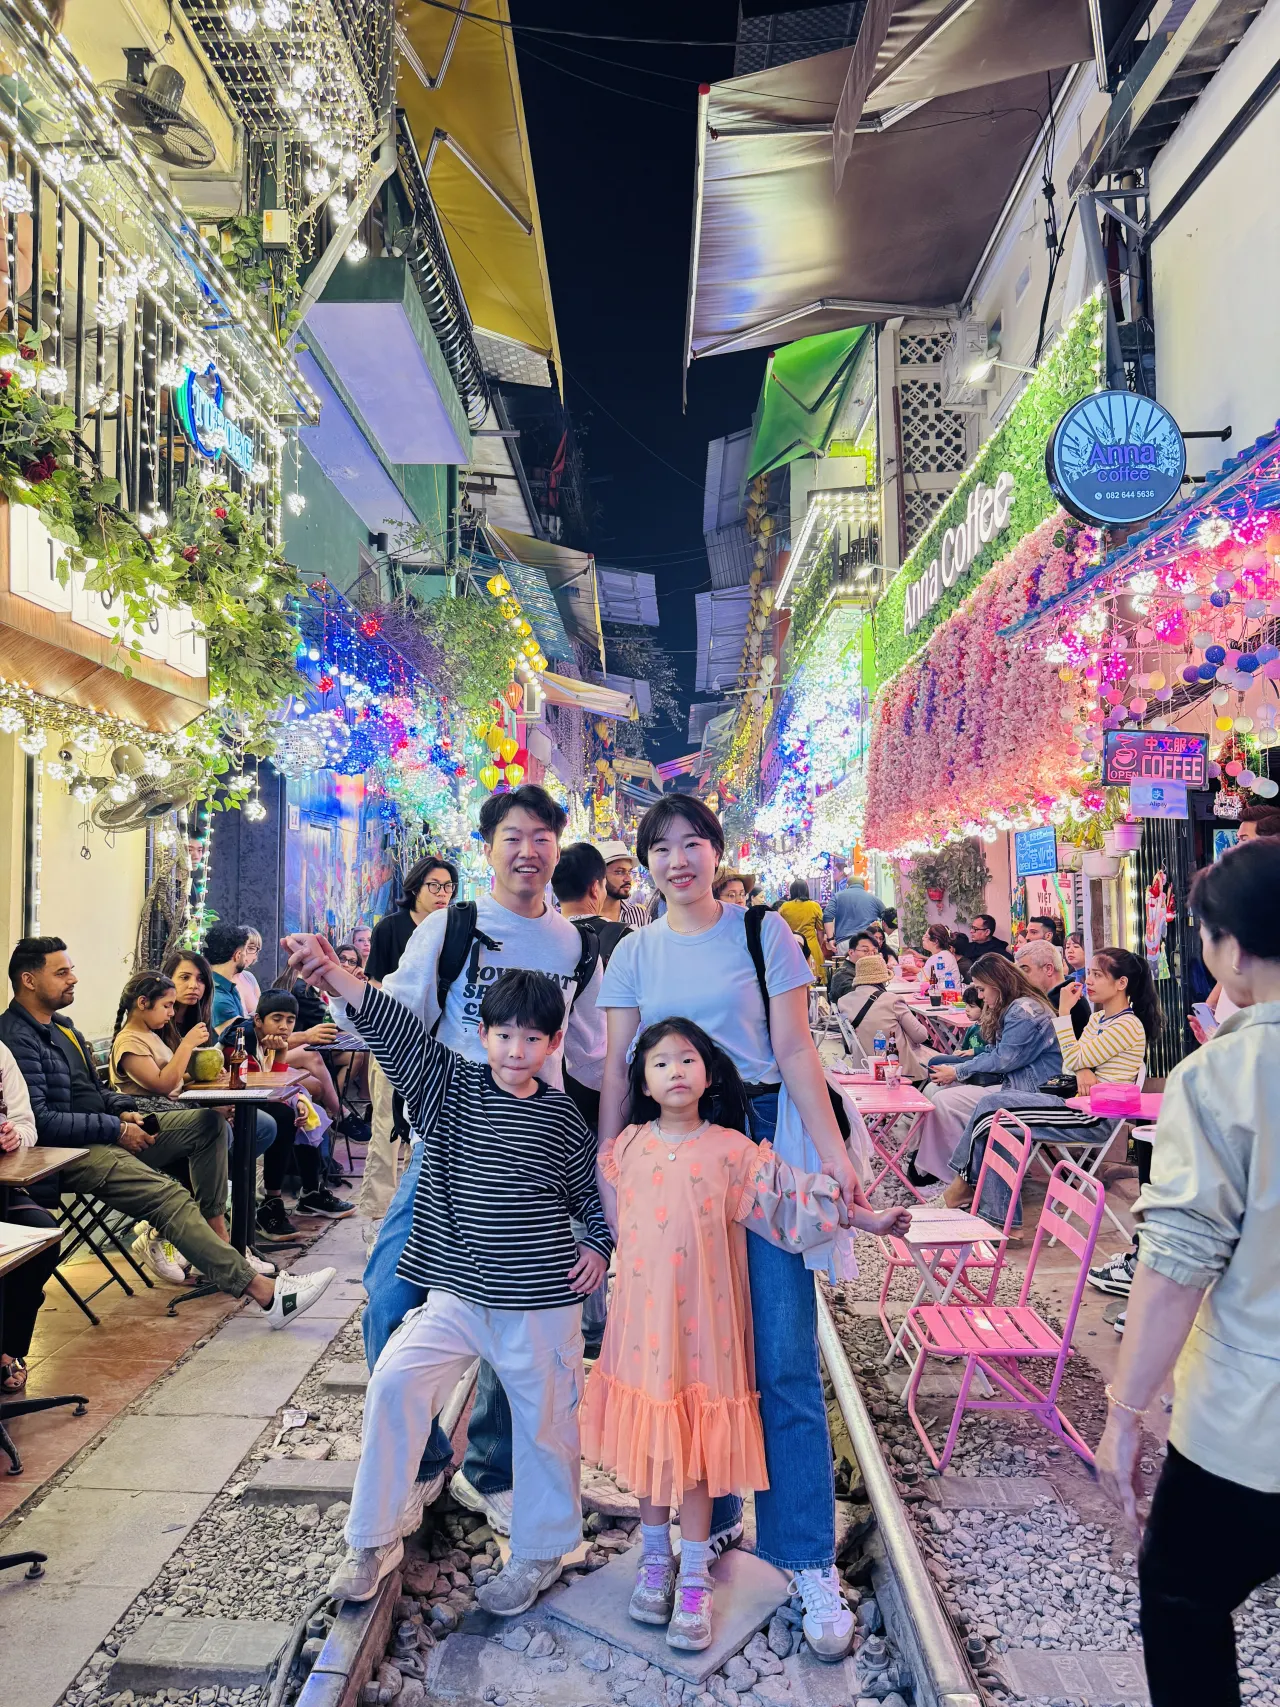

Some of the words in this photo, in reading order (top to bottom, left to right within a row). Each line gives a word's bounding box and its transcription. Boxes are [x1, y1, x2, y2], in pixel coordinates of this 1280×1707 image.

[1089, 442, 1156, 465] Anna
[1097, 466, 1150, 482] coffee
[1105, 491, 1120, 500] 082
[1121, 491, 1135, 499] 644
[1136, 490, 1155, 498] 5636
[904, 558, 945, 637] Anna
[941, 471, 1016, 589] Coffee
[1144, 736, 1203, 754] 中文服务
[1110, 770, 1139, 779] OPEN
[1141, 755, 1202, 780] COFFEE
[1028, 845, 1054, 870] 营业中
[1037, 891, 1052, 906] VIỆT
[1039, 906, 1052, 916] NAM
